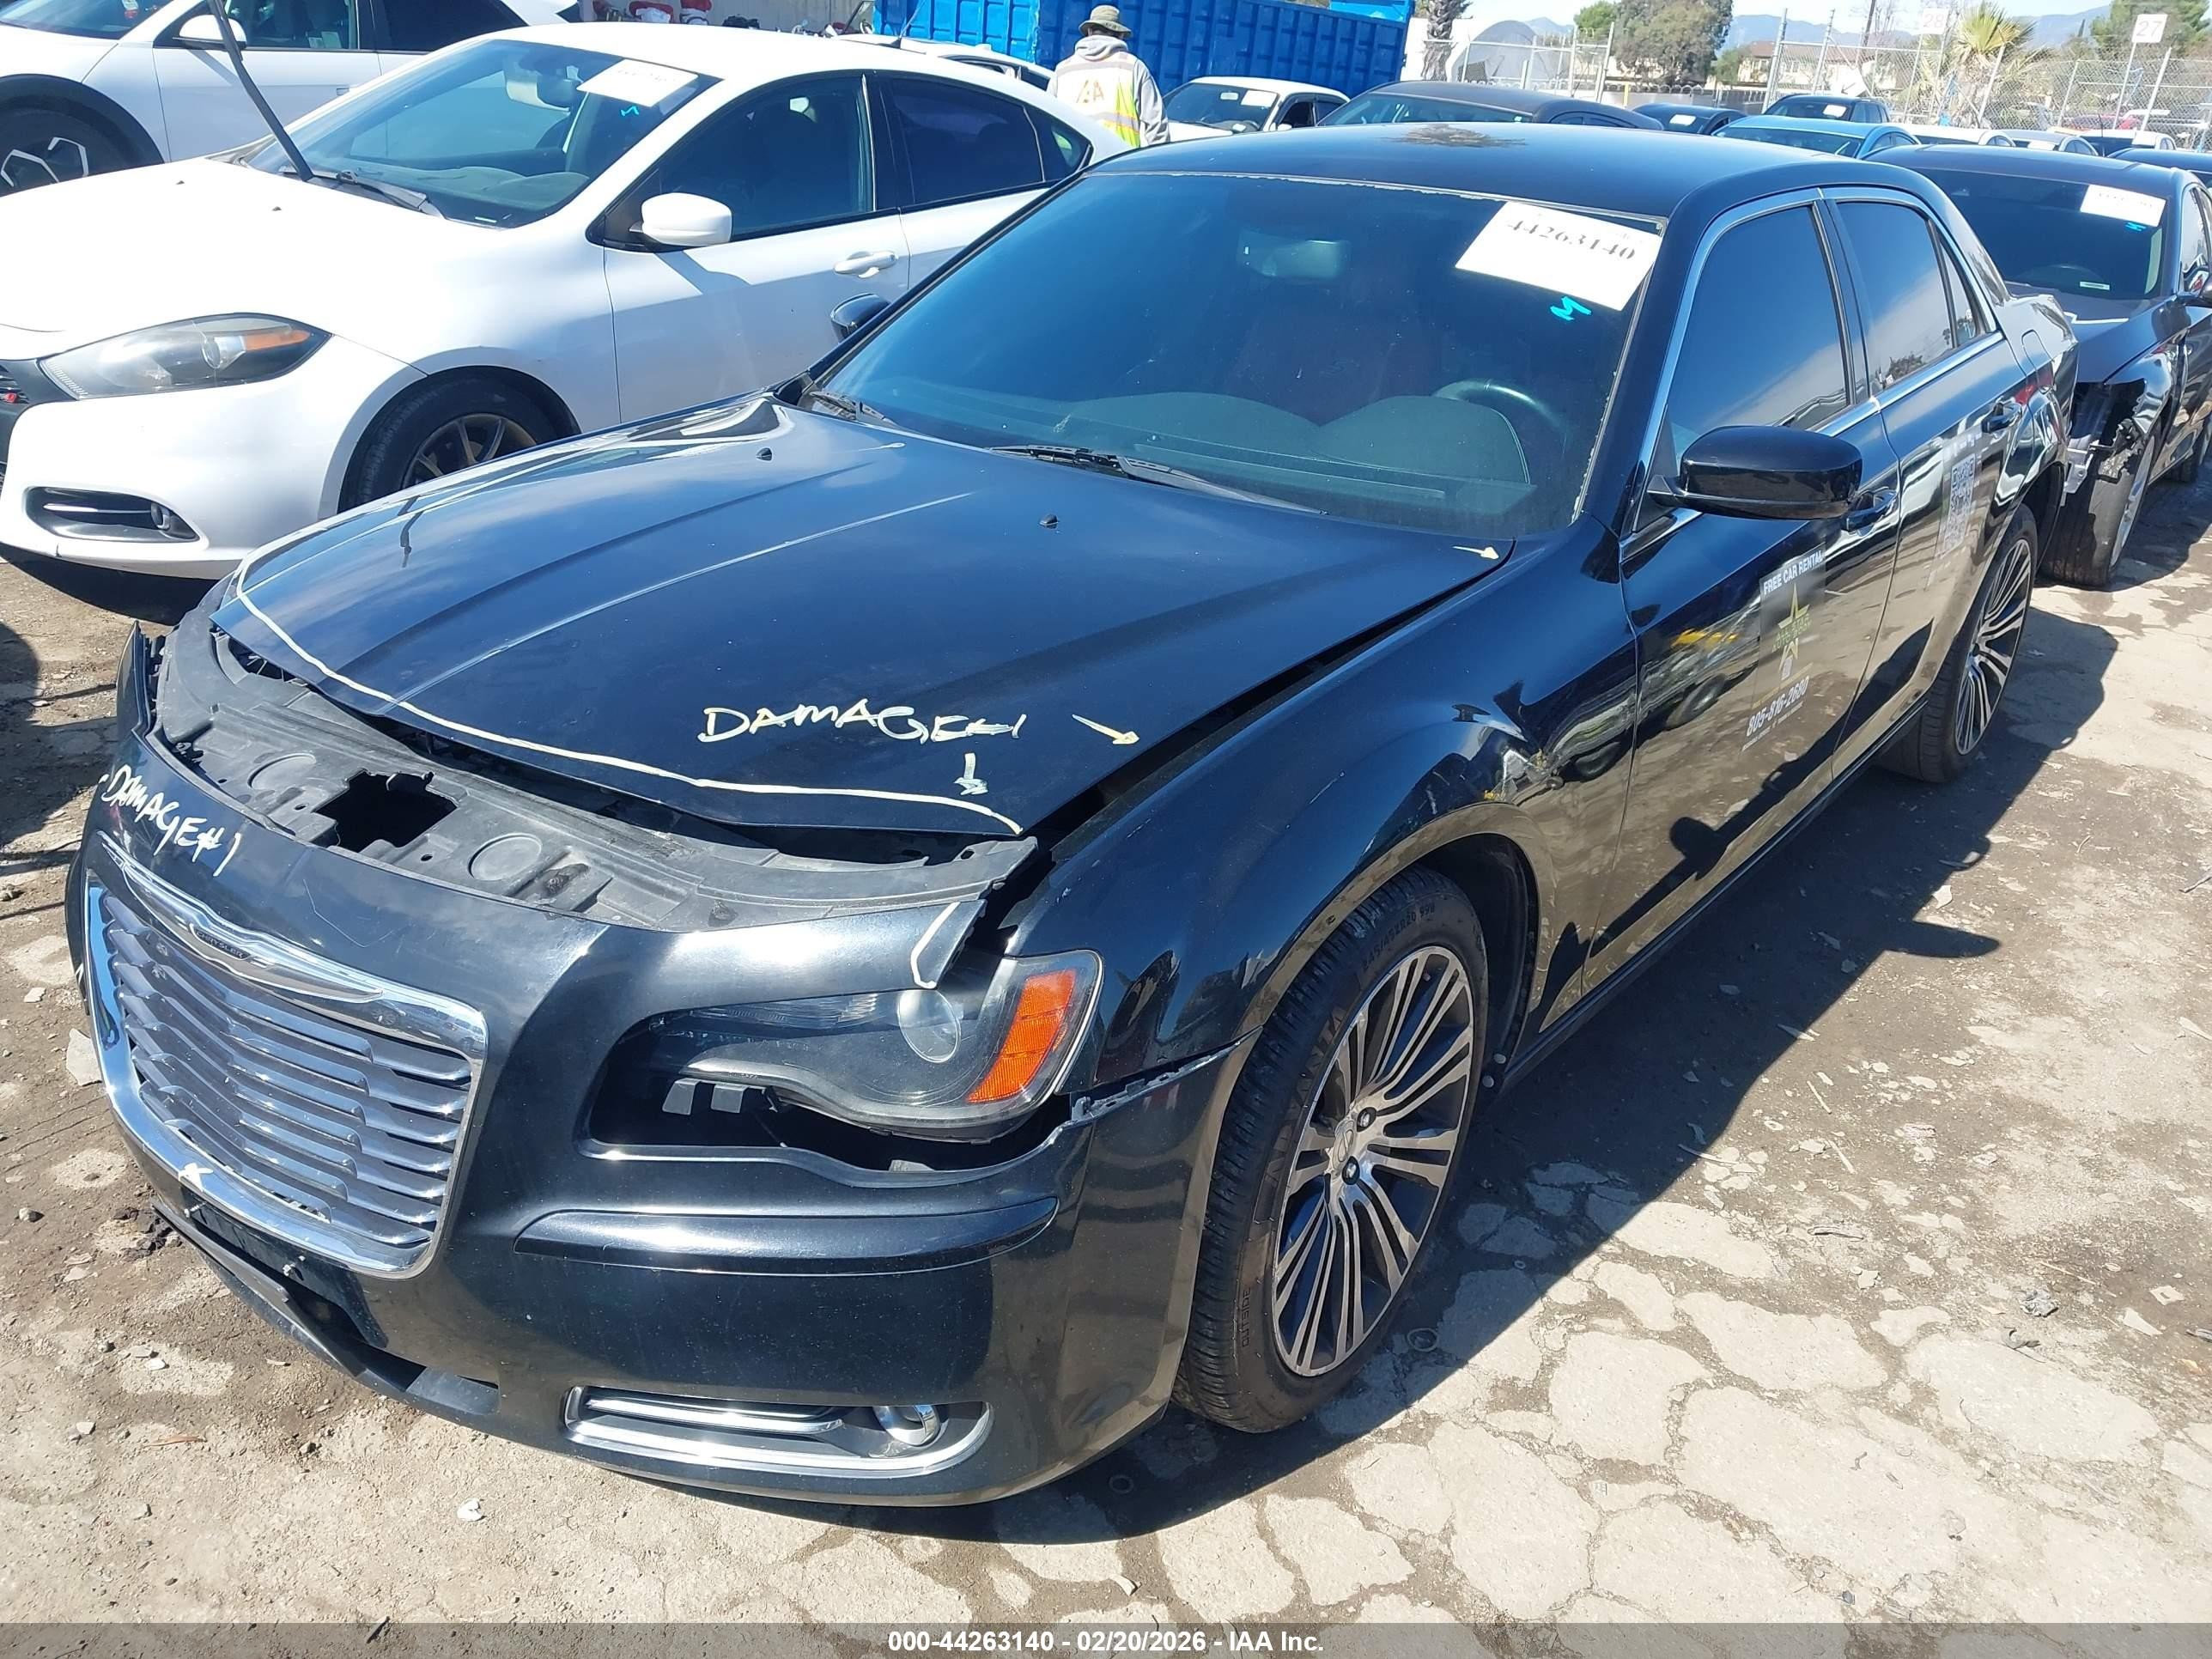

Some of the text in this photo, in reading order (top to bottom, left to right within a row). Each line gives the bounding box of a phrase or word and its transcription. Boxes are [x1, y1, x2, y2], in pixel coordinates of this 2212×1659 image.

[2136, 20, 2164, 38] 27
[1507, 220, 1636, 259] 44263140
[1763, 550, 1824, 596] FREE CAR RENTAL
[197, 931, 244, 959] CHRYSLER
[1240, 1287, 1251, 1347] OUTSIDE
